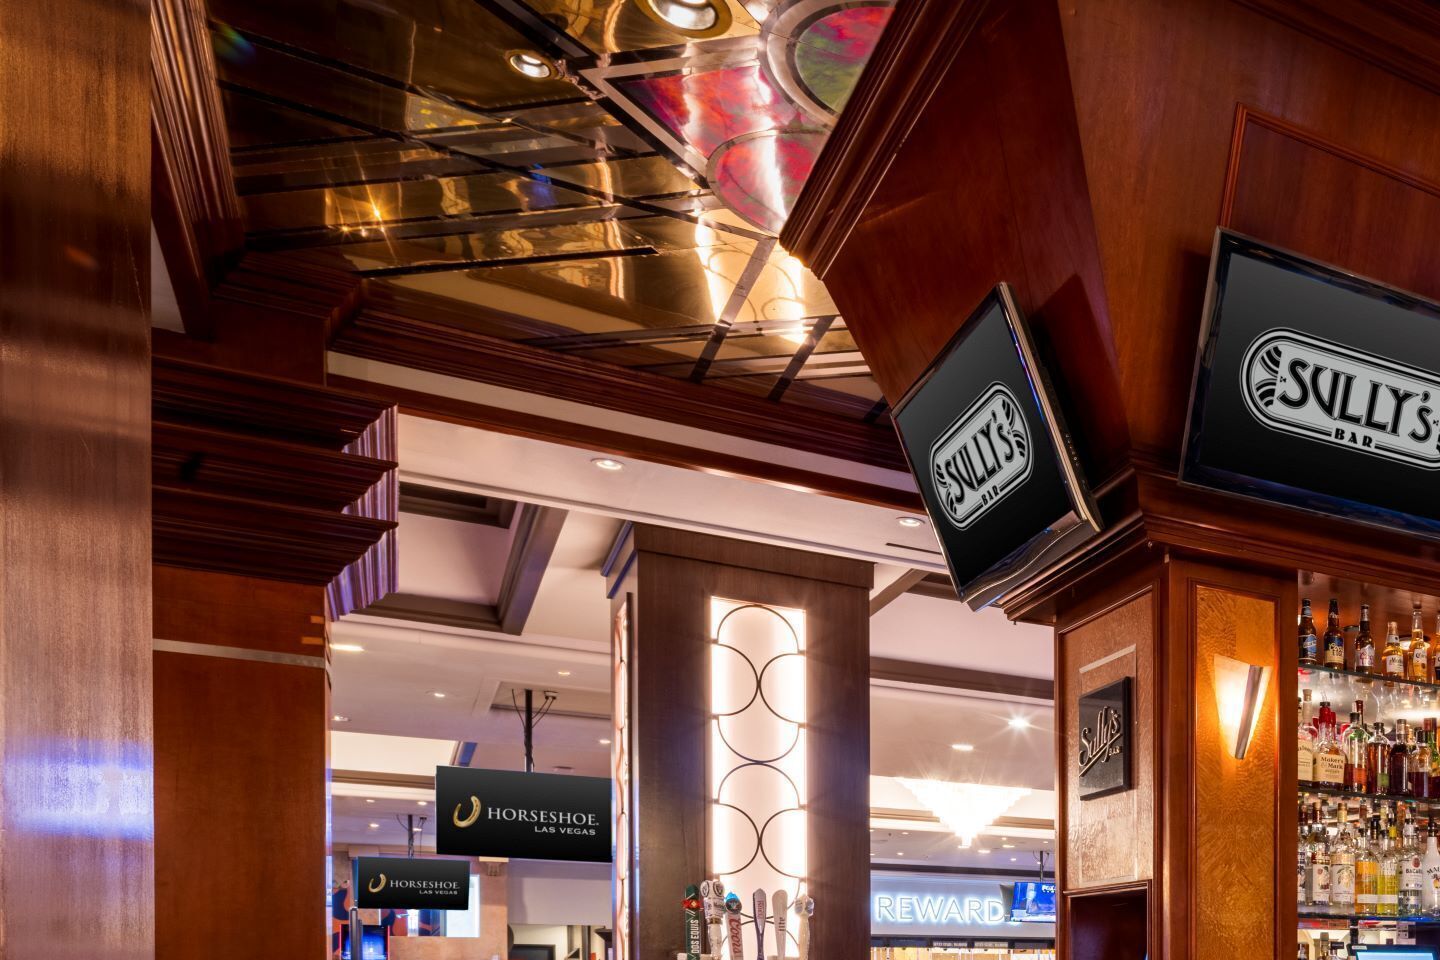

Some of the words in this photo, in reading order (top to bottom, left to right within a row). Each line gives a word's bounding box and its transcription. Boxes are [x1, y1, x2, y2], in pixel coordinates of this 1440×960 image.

[1334, 428, 1374, 448] BAR
[982, 485, 1000, 506] BAR
[1078, 706, 1121, 766] Sully's
[488, 807, 599, 826] HORSESHOE
[534, 826, 556, 834] LAS
[559, 827, 596, 836] VEGAS
[390, 879, 460, 889] HORSESHOE
[877, 896, 1008, 923] REWARD
[690, 919, 699, 940] EQUIS
[690, 940, 699, 954] DOS
